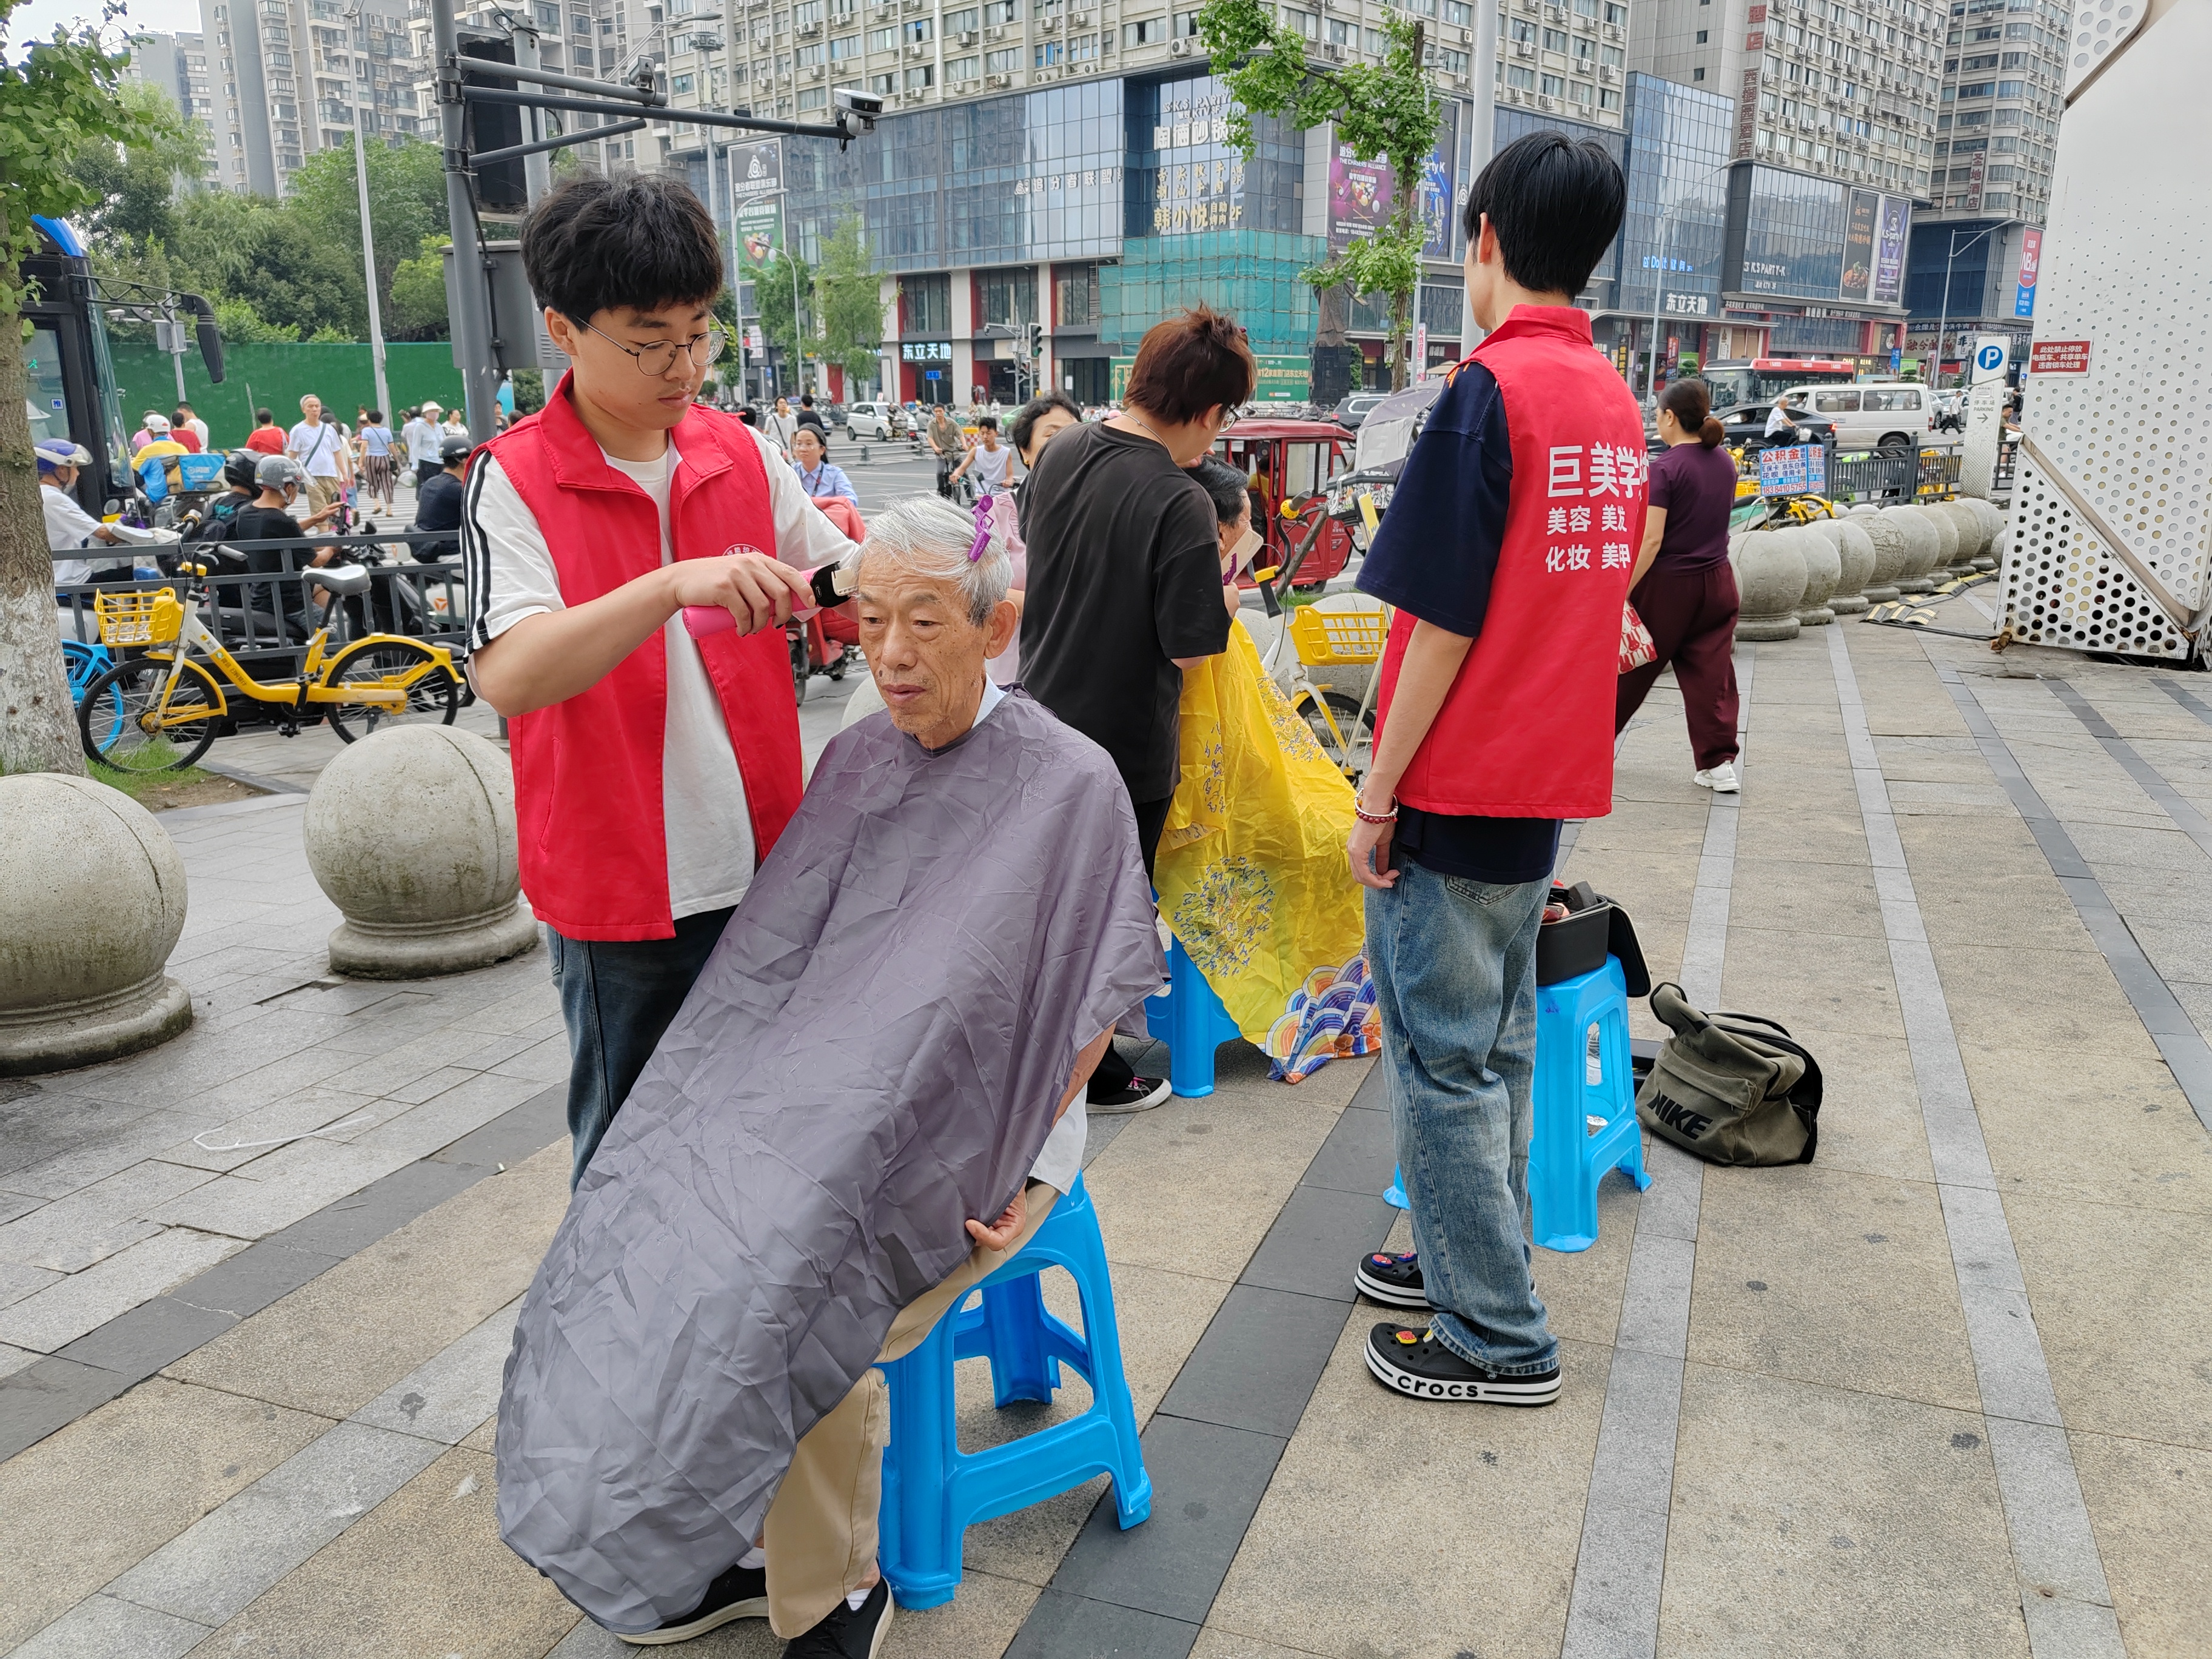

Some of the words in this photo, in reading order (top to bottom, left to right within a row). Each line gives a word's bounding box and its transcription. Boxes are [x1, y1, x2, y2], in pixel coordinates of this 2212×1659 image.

[1196, 93, 1230, 108] PARTY
[1967, 153, 1983, 208] 圣地酒店
[1154, 203, 1208, 230] 韩小悦
[1230, 206, 1242, 221] 2F
[1211, 201, 1227, 213] 自助
[1666, 293, 1708, 314] 东立天地
[902, 343, 951, 360] 东立天地
[1762, 448, 1799, 462] 公积金
[1774, 484, 1789, 493] 8410
[1791, 483, 1806, 491] 5755
[1547, 505, 1592, 535] 美容
[1601, 504, 1627, 532] 美发
[1546, 544, 1591, 572] 化妆
[1601, 542, 1631, 569] 美甲
[1646, 1088, 1713, 1140] NIKE
[1397, 1375, 1478, 1398] crocs
